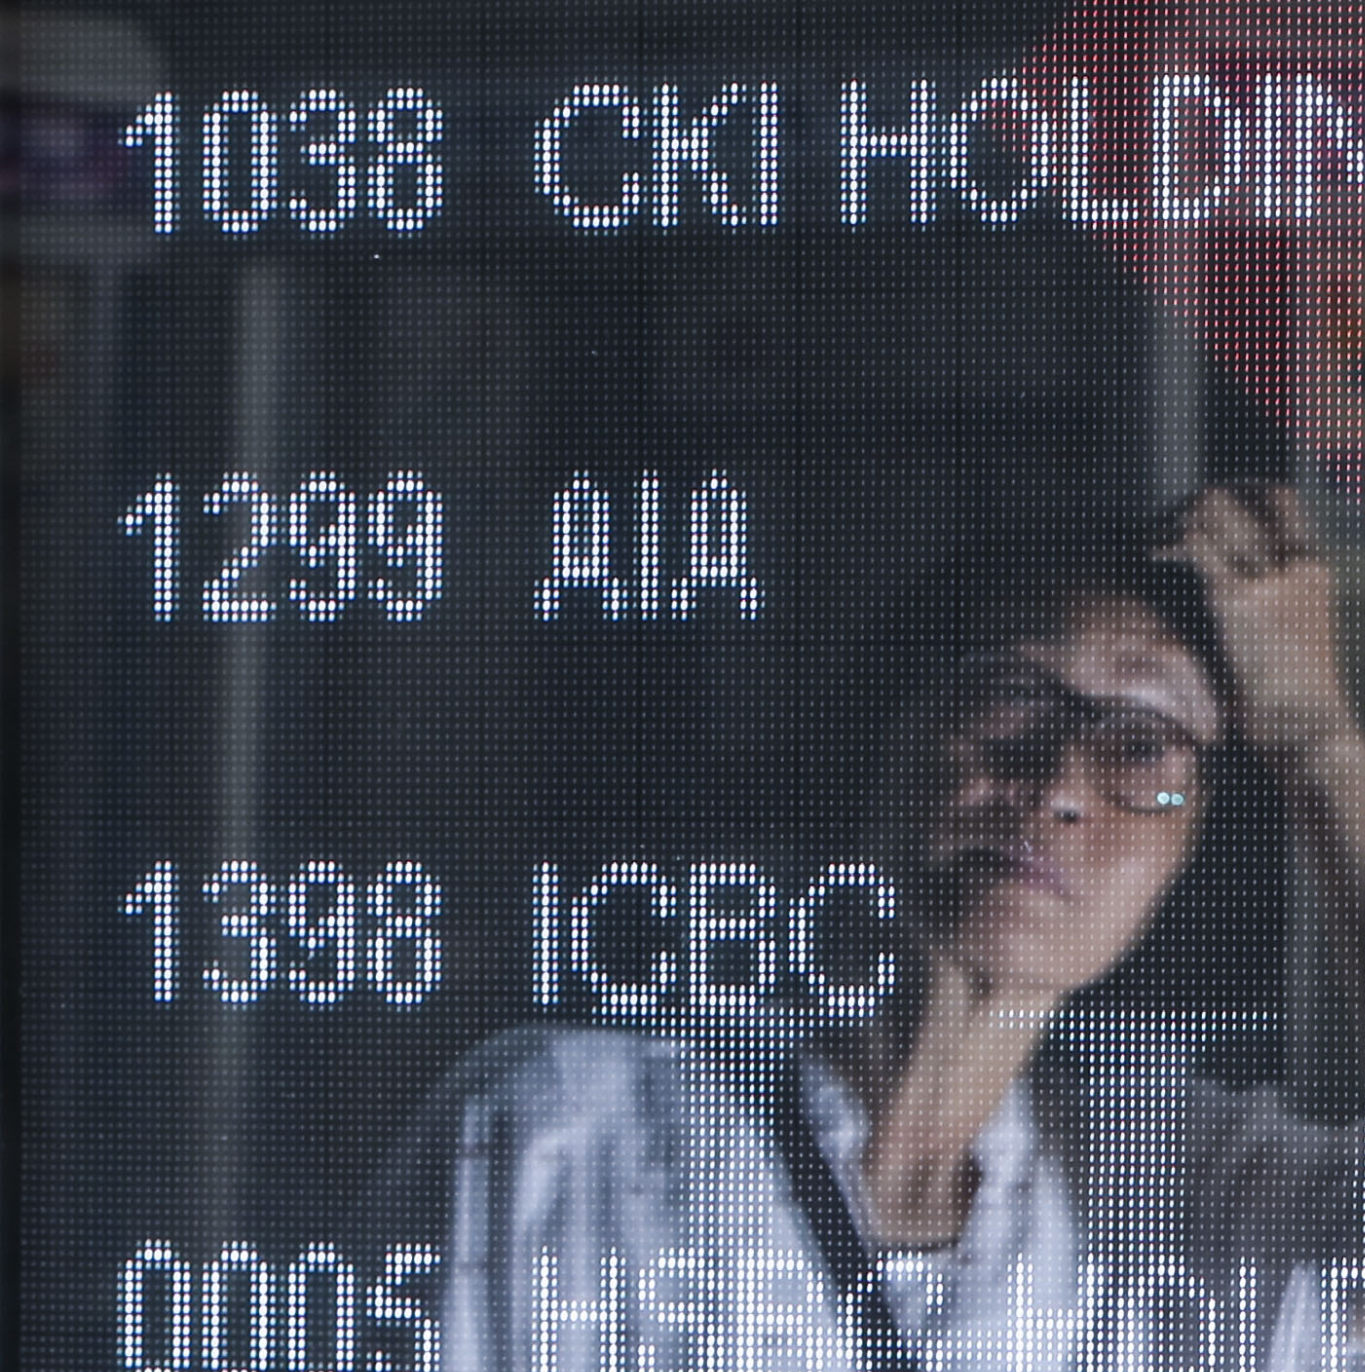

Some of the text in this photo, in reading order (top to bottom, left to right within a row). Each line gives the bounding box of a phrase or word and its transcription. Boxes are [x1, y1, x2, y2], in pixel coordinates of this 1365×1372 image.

[118, 86, 444, 235] 1038
[534, 80, 780, 230] CKI
[118, 470, 444, 622] 1299
[534, 468, 766, 622] AIA
[118, 858, 444, 1006] 1398
[532, 860, 900, 1012] ICBC
